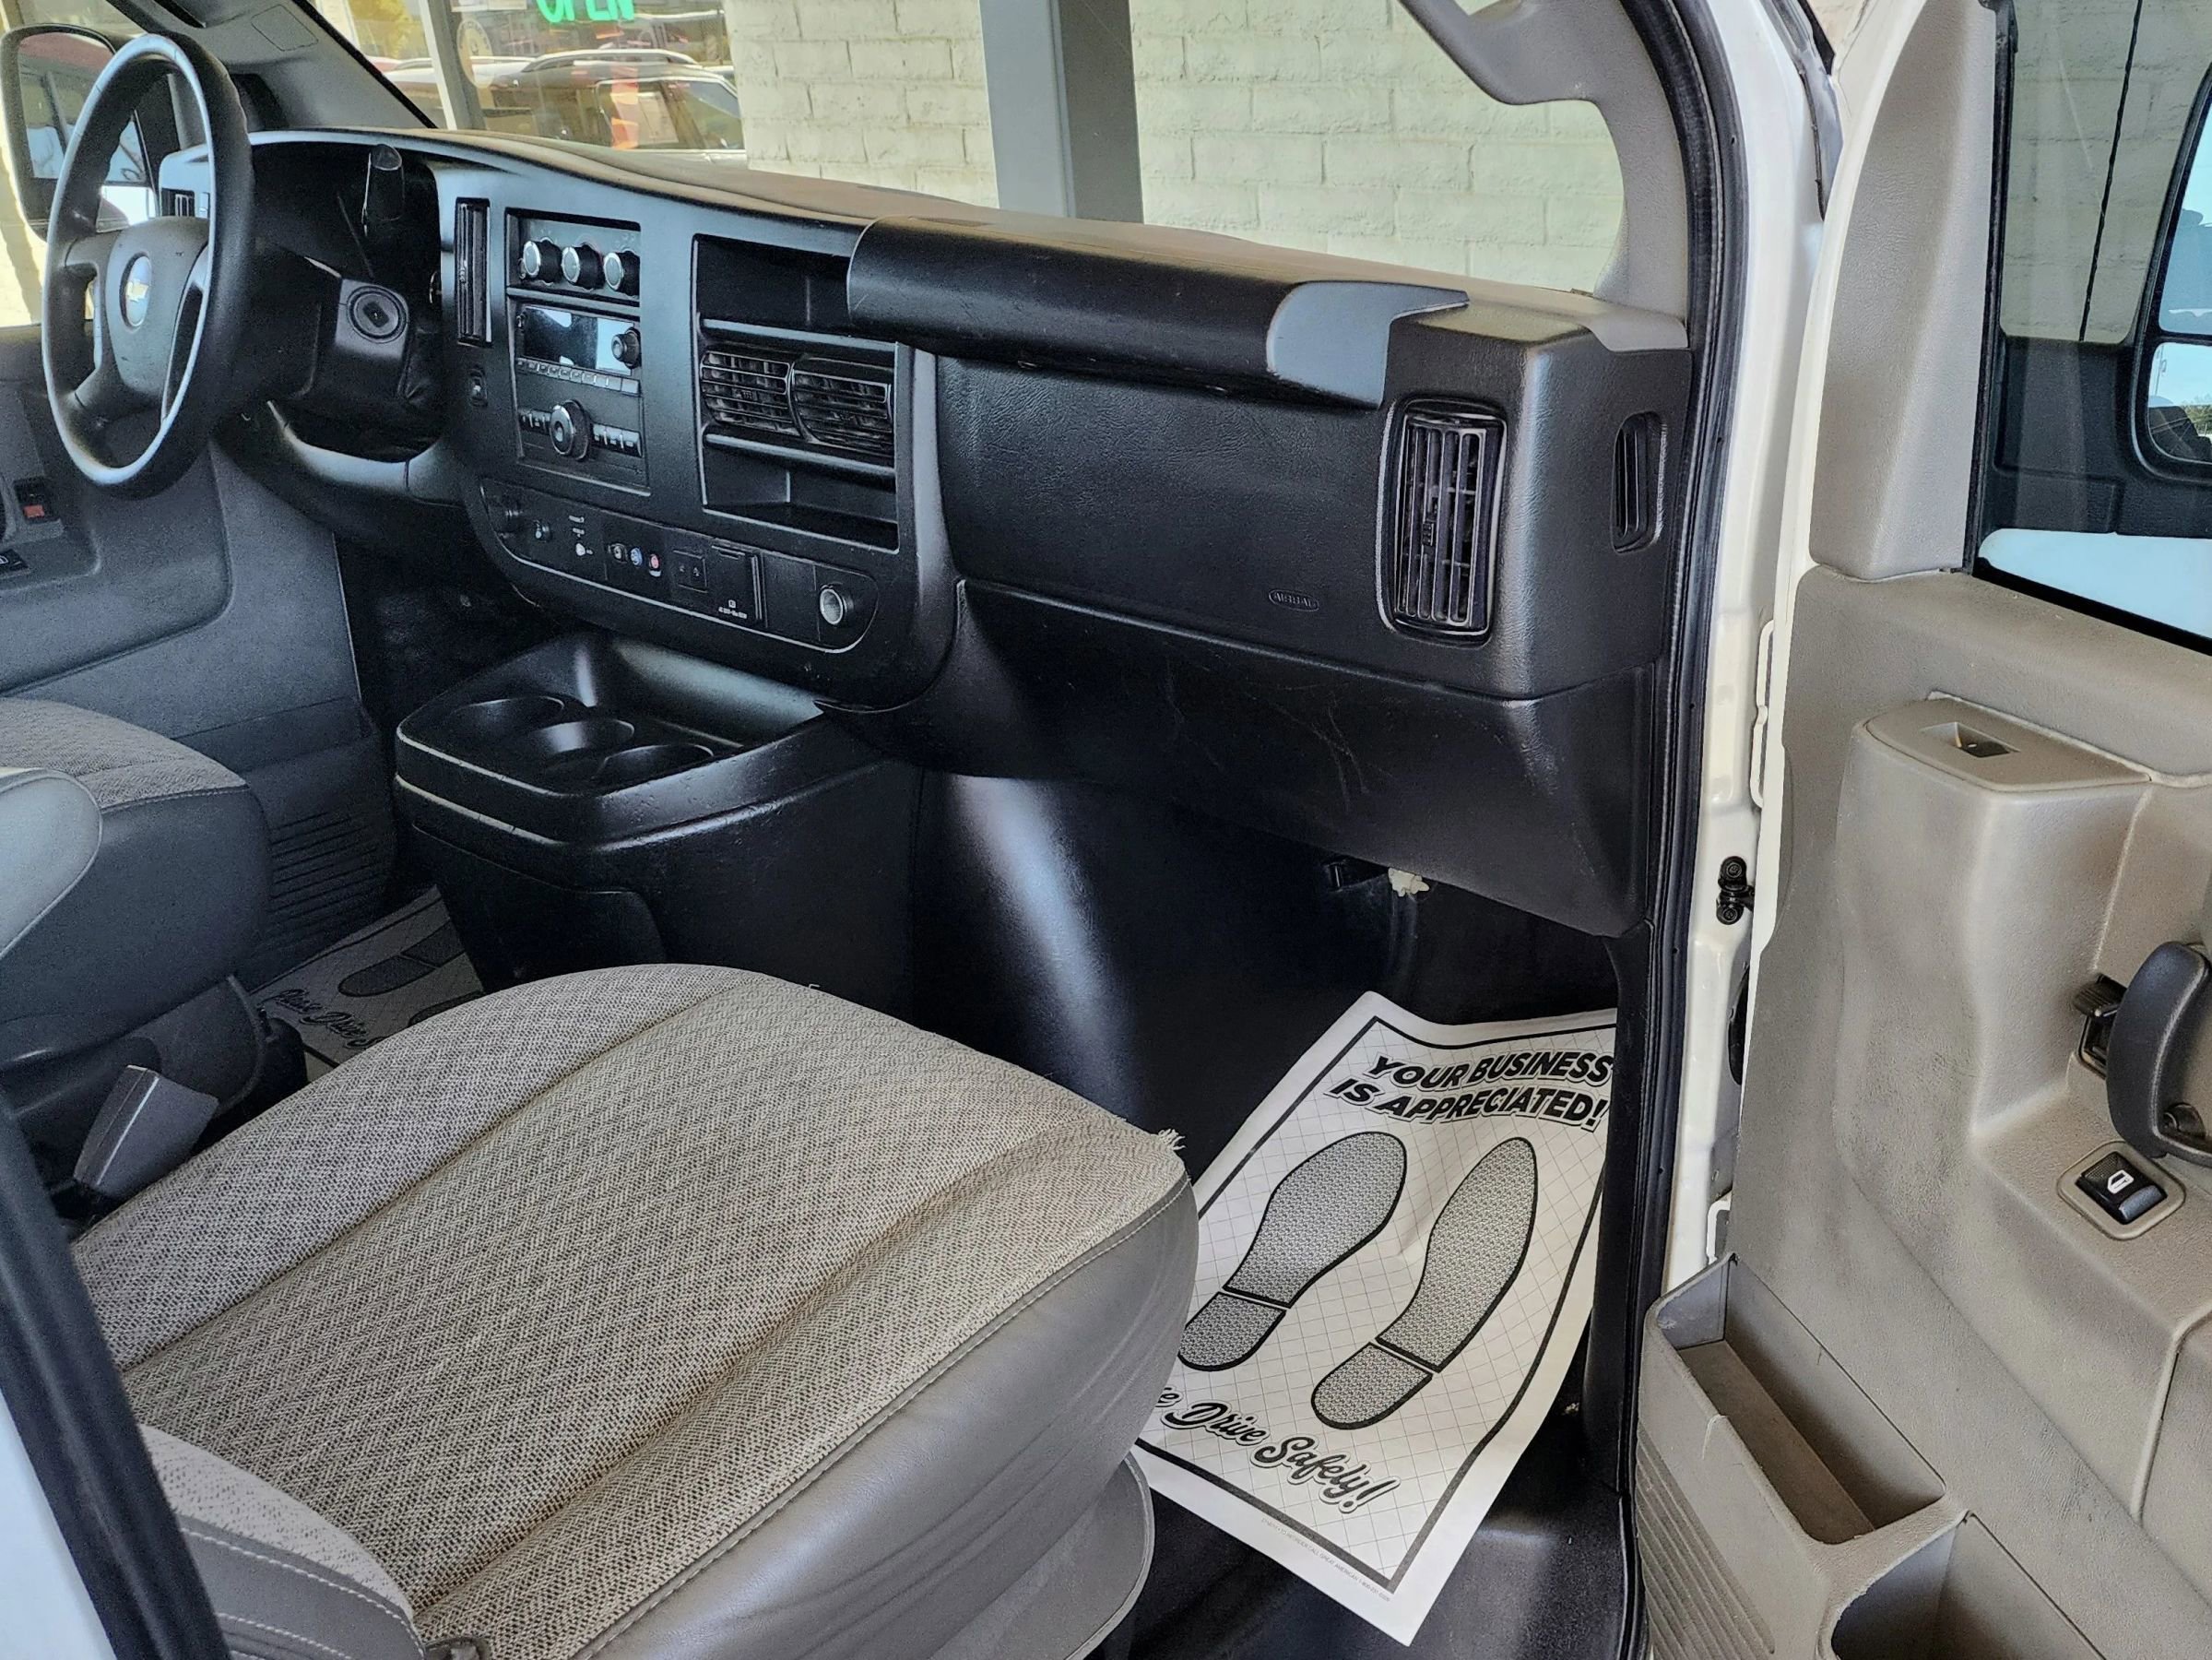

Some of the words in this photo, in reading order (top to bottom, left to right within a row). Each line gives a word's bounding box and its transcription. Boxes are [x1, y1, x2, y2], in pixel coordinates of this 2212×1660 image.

[1368, 1055, 1471, 1088] YOUR
[1468, 1050, 1613, 1083] BUSINESS
[1331, 1078, 1381, 1102] IS
[1373, 1087, 1608, 1127] APPRECIATED!
[1164, 1402, 1267, 1442] Drive
[1253, 1436, 1398, 1509] Safely!
